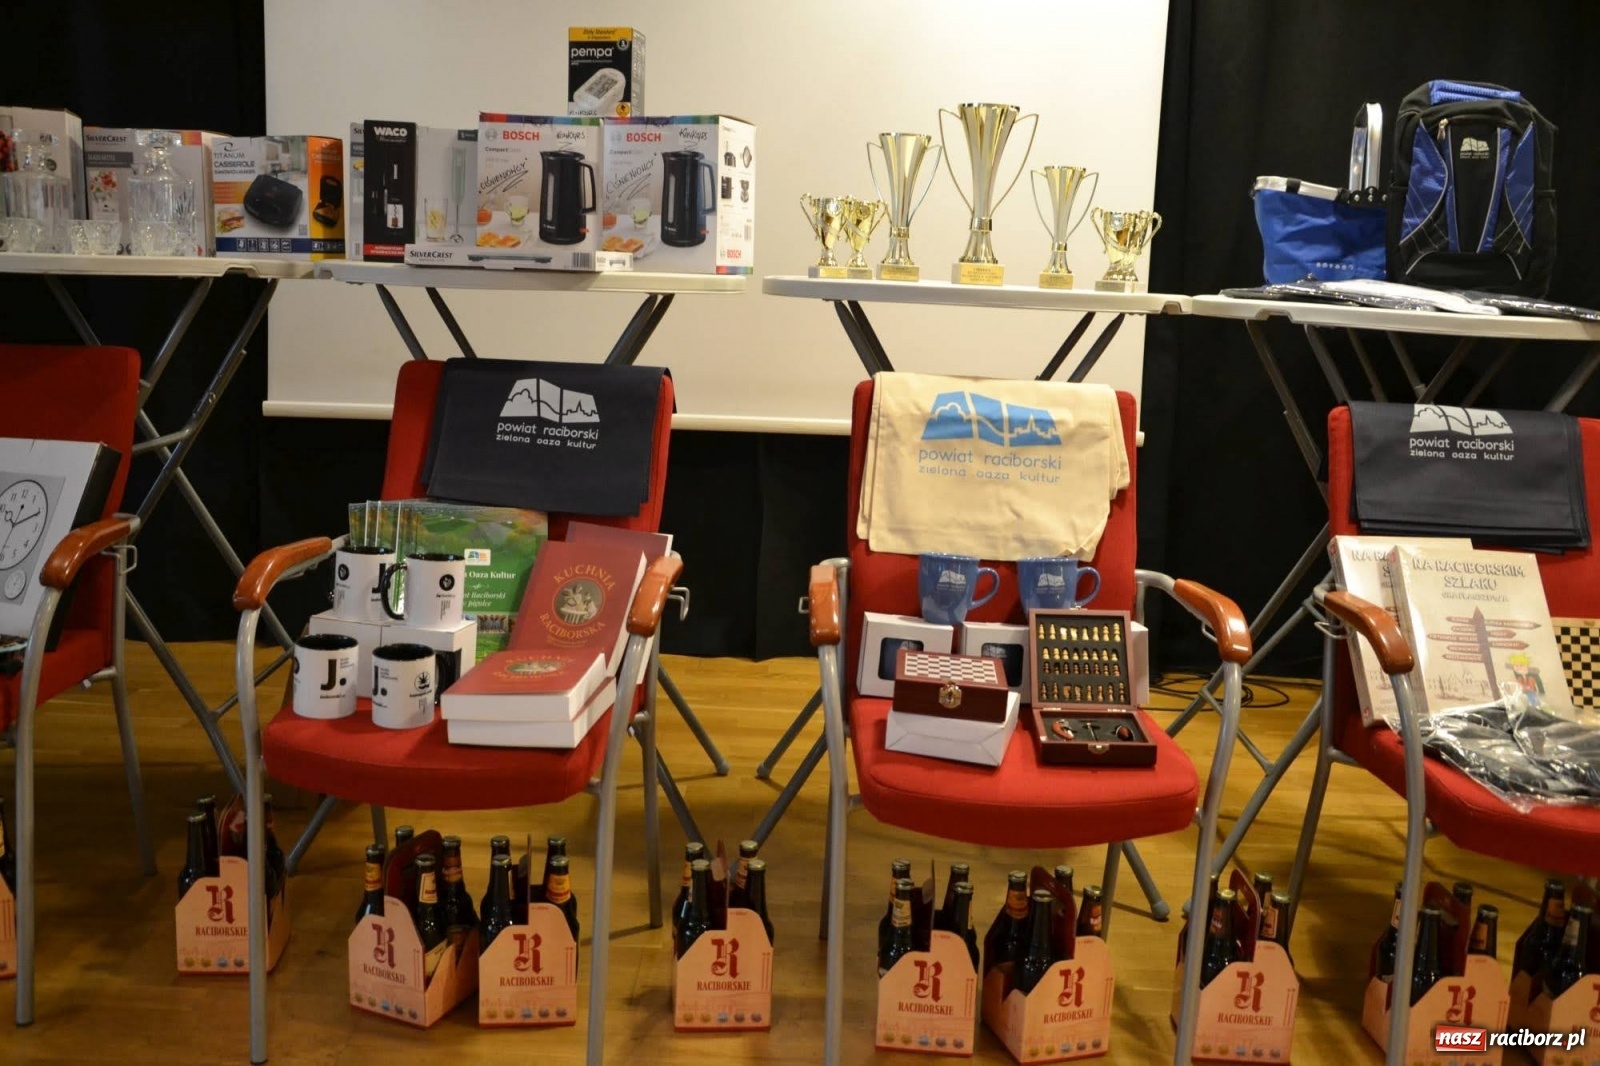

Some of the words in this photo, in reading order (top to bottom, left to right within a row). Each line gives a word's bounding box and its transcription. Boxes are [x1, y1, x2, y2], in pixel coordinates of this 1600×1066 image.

[571, 48, 612, 58] pempa
[374, 127, 408, 136] WACO
[502, 131, 540, 140] BOSCH
[626, 133, 662, 142] BOSCH
[214, 160, 255, 168] CASSEROLE
[726, 250, 742, 258] BOSCH
[497, 422, 536, 434] powiat
[544, 426, 599, 440] raciborski
[496, 434, 530, 443] zielona
[536, 438, 560, 446] oaza
[566, 440, 597, 449] kultur
[1410, 437, 1450, 448] powiat
[1457, 438, 1514, 451] raciborski
[918, 448, 974, 463] powiat
[984, 452, 1062, 470] raciborski
[1410, 449, 1444, 458] zielona
[1484, 452, 1514, 460] kultur
[918, 465, 966, 477] zielona
[976, 470, 1010, 480] oaza
[1020, 471, 1060, 483] kultur
[490, 571, 516, 579] Kultur
[1412, 558, 1432, 570] NA
[1434, 560, 1526, 578] RACIBORSKIM
[553, 564, 616, 592] KUCHNIA
[1444, 575, 1498, 590] SZLAKU
[540, 612, 606, 639] RACIBORSKA
[363, 964, 407, 985] RACIBORSKIE
[500, 976, 556, 987] RACIBORSKIE
[696, 980, 751, 992] RACIBORSKIE
[898, 1002, 954, 1016] RACIBORSKIE
[1043, 1008, 1094, 1024] RACIBORSKIE
[1218, 1012, 1274, 1026] RACIBORSKIE
